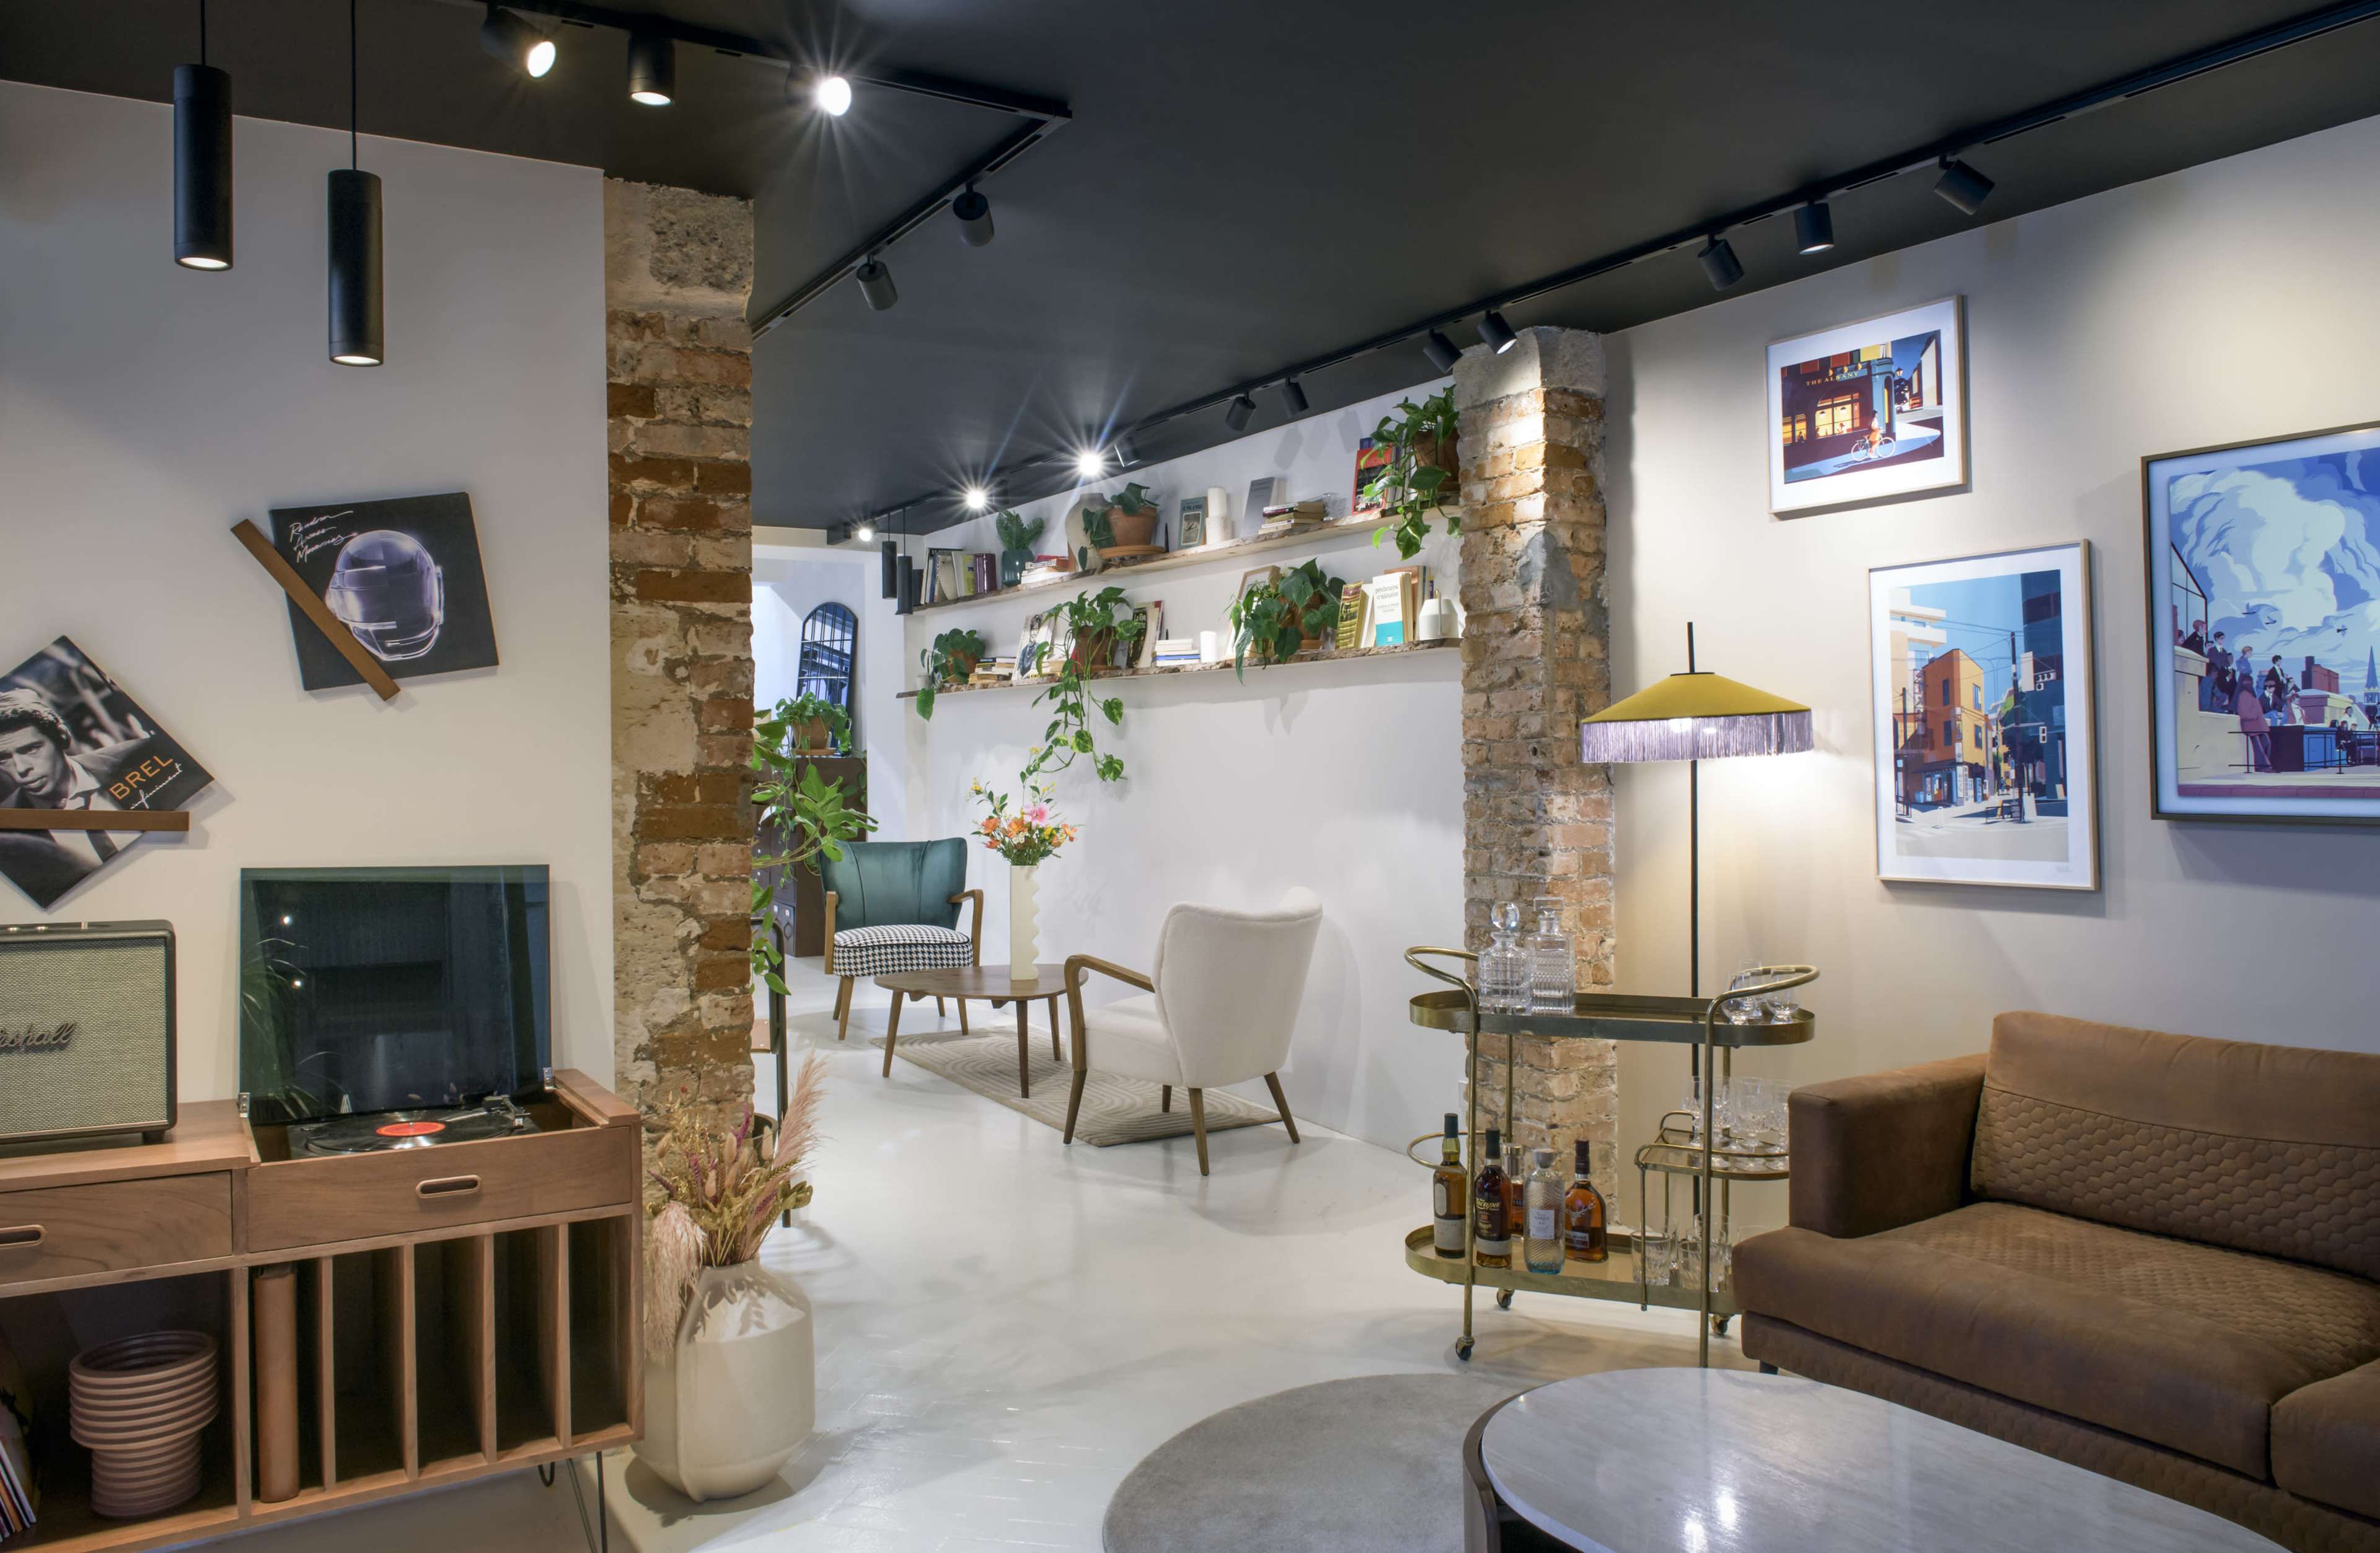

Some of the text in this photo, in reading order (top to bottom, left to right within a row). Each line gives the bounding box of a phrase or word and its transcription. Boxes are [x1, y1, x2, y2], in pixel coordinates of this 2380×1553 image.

[1824, 371, 1858, 382] ALBANY
[289, 510, 354, 543] Random
[296, 532, 358, 563] Memories
[108, 755, 174, 801] BREL
